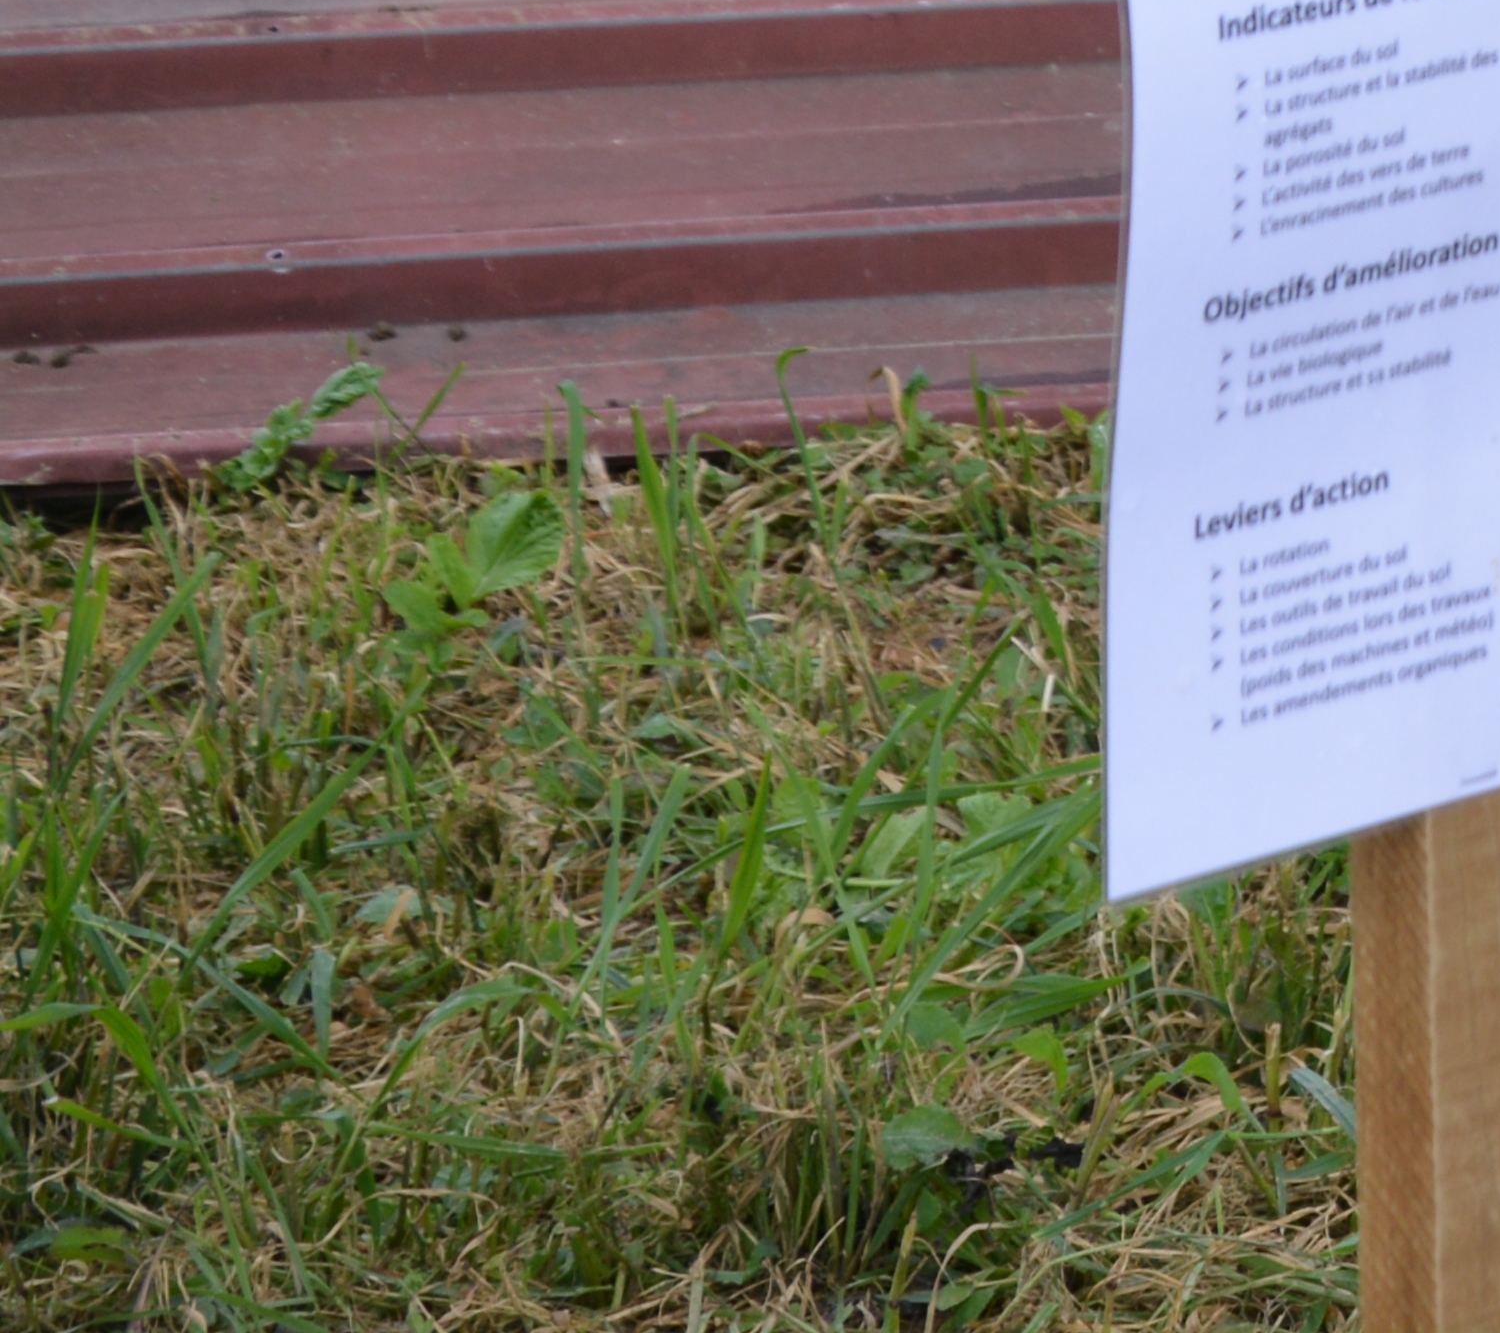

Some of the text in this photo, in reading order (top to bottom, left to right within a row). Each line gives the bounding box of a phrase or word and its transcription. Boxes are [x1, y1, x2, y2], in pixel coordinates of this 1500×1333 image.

[1265, 39, 1398, 88] La surface du sol
[1265, 50, 1498, 117] La structure et la stabilité des
[1265, 118, 1332, 148] agrégats
[1261, 170, 1483, 237] L'enracinement des cultures
[1262, 145, 1470, 207] L'activité des vers de terre
[1205, 233, 1499, 323] Objectifs d'amélioration
[1250, 283, 1500, 358] La circulation de l'air et de l'eau
[1248, 340, 1383, 388] La vie biologique
[1195, 471, 1389, 540] Leviers d'action
[1240, 539, 1330, 576] La rotation
[1240, 544, 1407, 606] La couverture du sol
[1240, 586, 1490, 666] Les conditions lors des travaux
[1241, 611, 1493, 698] (poids des machines et météo)
[1242, 644, 1487, 726] Les amendements organiques
